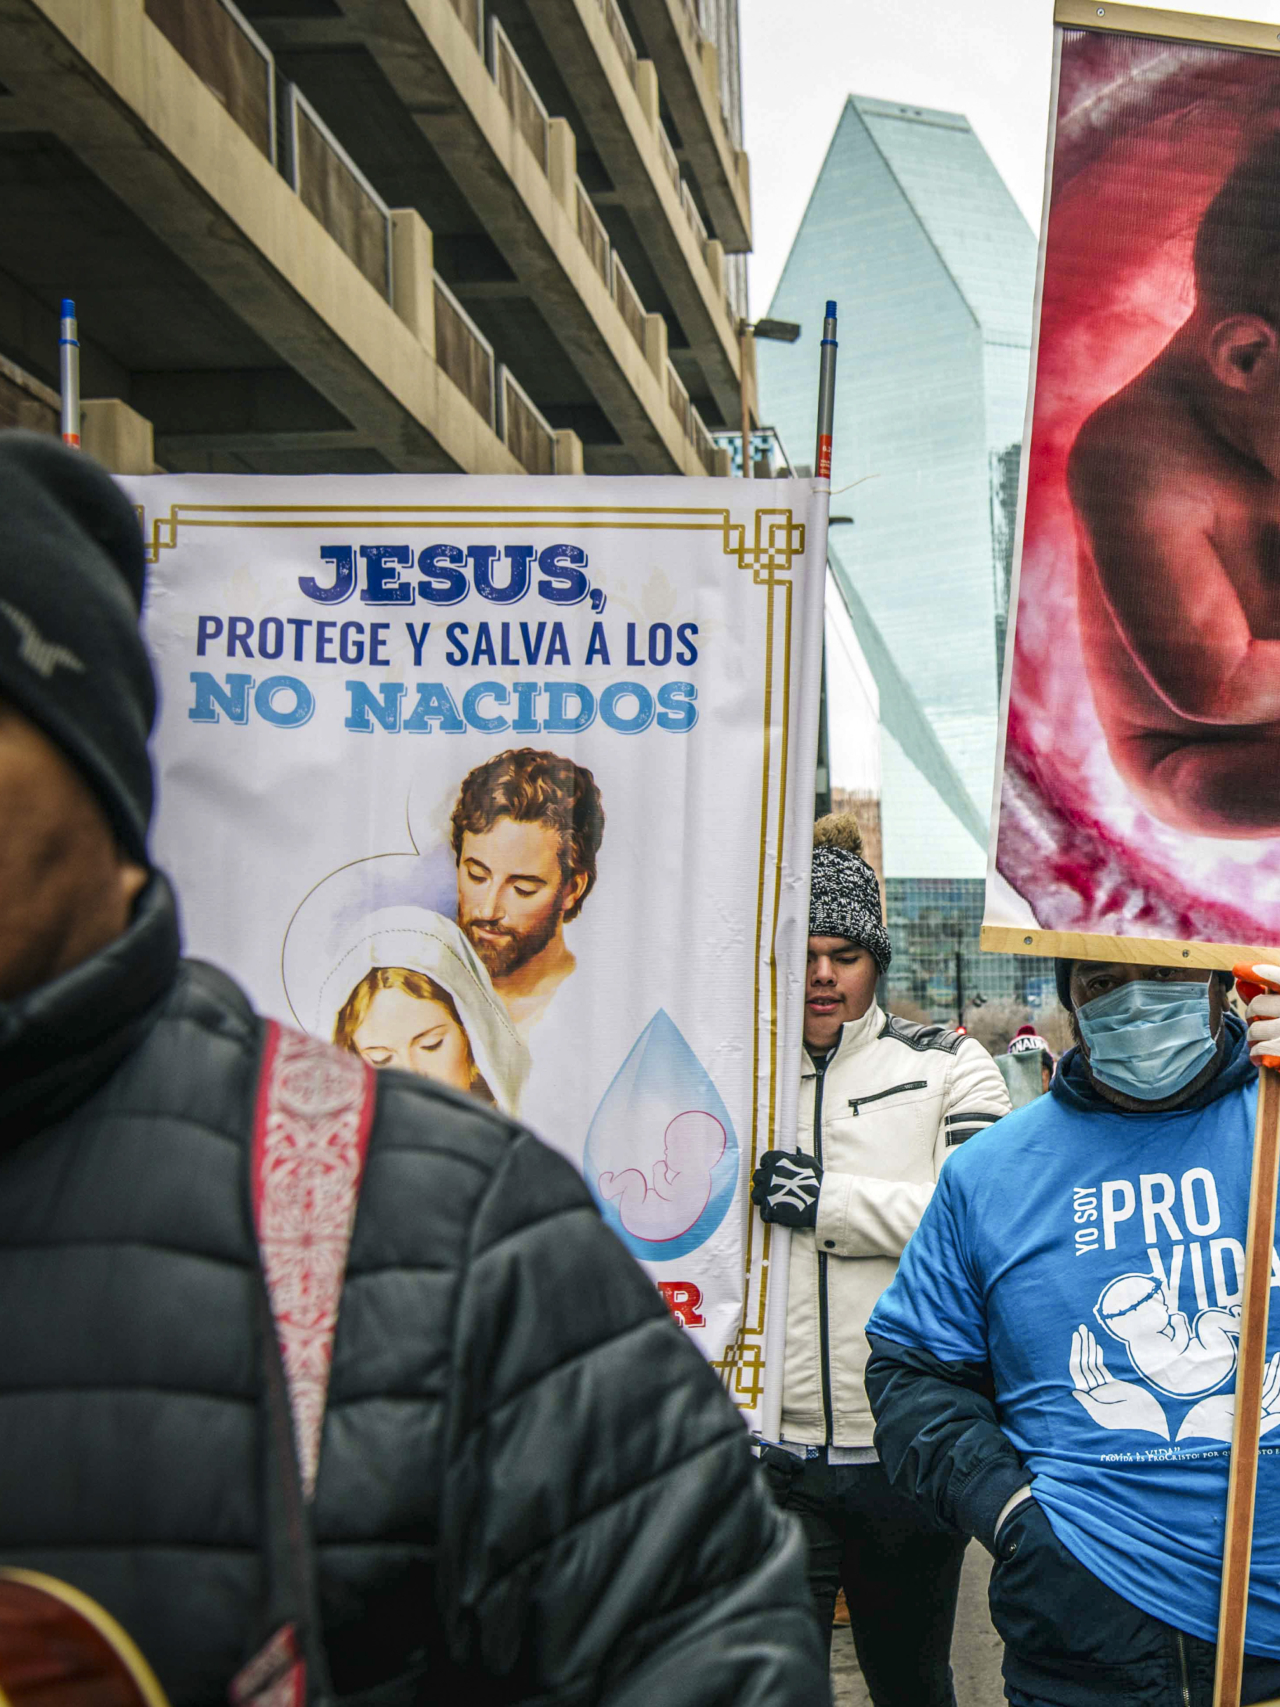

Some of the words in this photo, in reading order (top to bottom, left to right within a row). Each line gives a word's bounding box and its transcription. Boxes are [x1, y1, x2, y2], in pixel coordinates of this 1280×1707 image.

[298, 544, 607, 614] JESUS,
[197, 615, 390, 666] PROTEGE
[405, 622, 431, 666] Y
[446, 621, 571, 667] SALVA
[627, 622, 699, 667] LOS
[188, 671, 315, 729] NO
[344, 681, 699, 735] NACIDOS
[1073, 1187, 1098, 1224] SOY
[1101, 1167, 1221, 1251] PRO
[1074, 1227, 1099, 1257] YO
